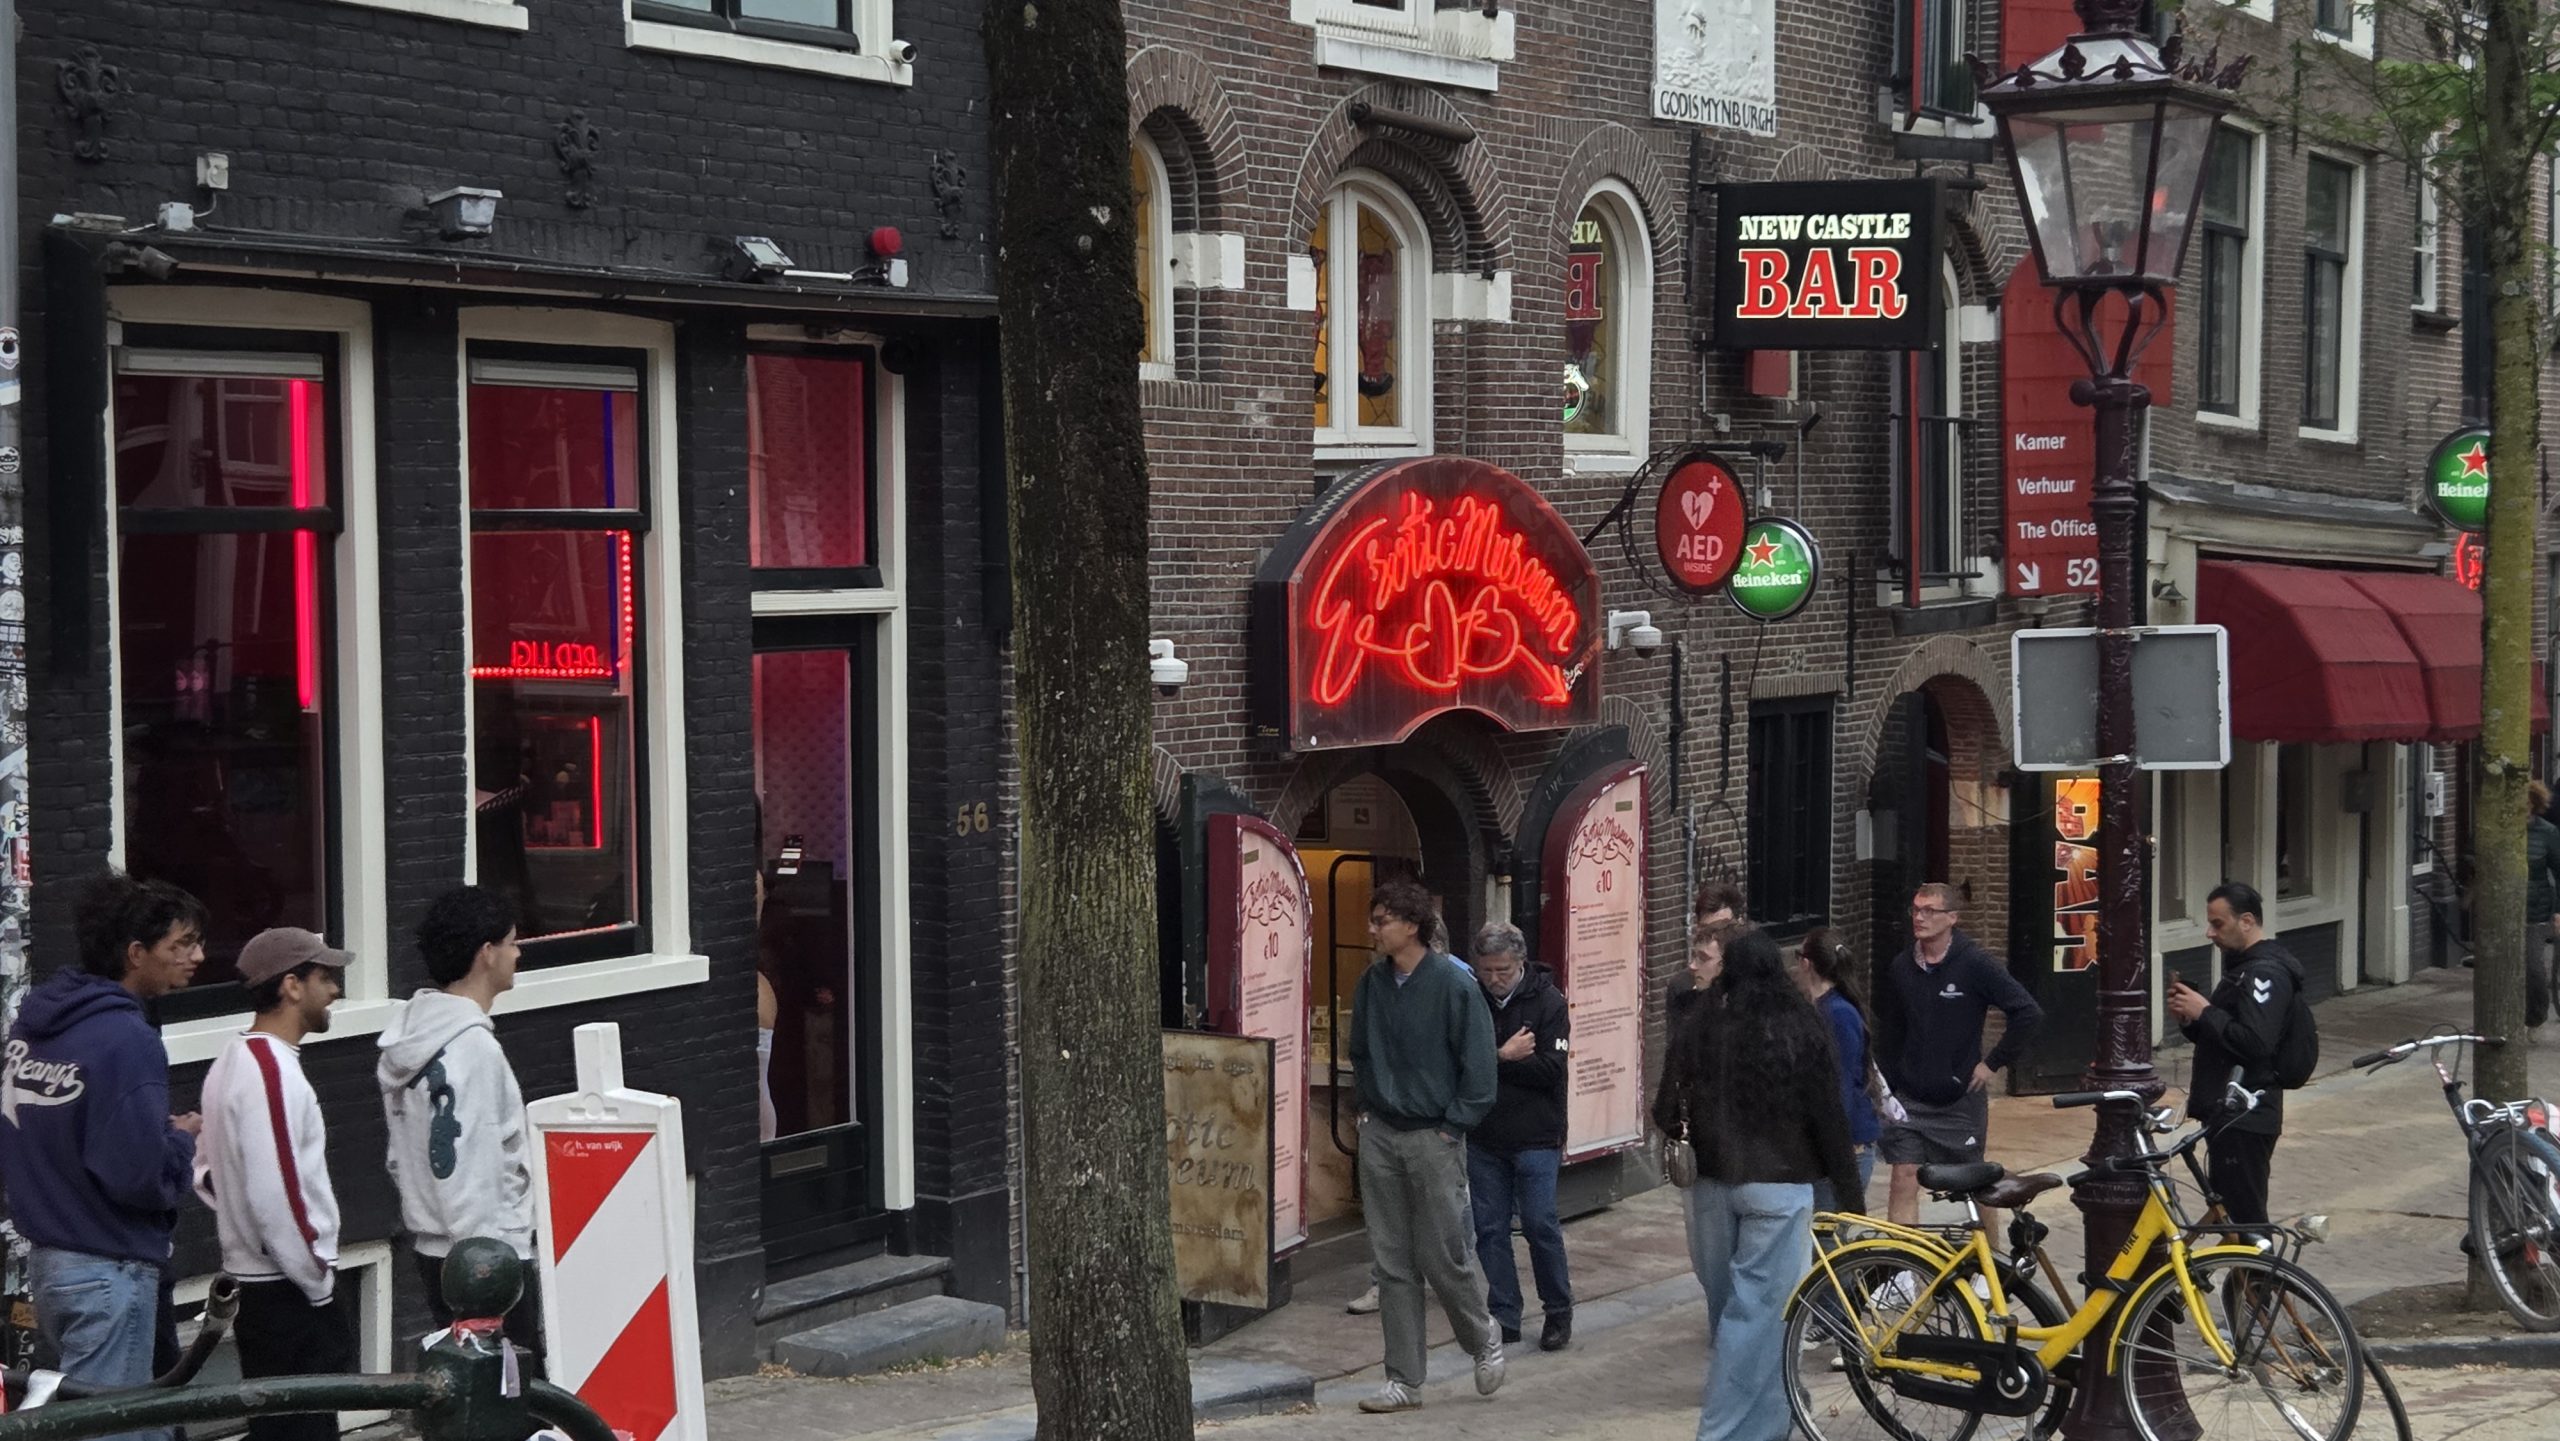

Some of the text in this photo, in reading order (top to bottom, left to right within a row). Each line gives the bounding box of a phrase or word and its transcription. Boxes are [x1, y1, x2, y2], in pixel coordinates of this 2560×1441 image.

[1739, 213, 1911, 241] NEW CASTLE
[1737, 247, 1908, 319] BAR
[2015, 433, 2066, 450] Kamer
[2017, 477, 2076, 494] Verhuur
[2438, 482, 2490, 498] Heine
[2017, 519, 2098, 539] The Office
[1676, 533, 1724, 562] AED
[1453, 495, 1576, 652] Museum
[1683, 561, 1713, 574] INSIDE
[1732, 571, 1803, 588] Heineken
[2066, 557, 2099, 587] 52
[956, 801, 989, 838] 56
[1596, 869, 1613, 894] €10
[1264, 931, 1279, 960] €10
[1166, 1111, 1237, 1150] otic
[586, 1142, 602, 1150] van
